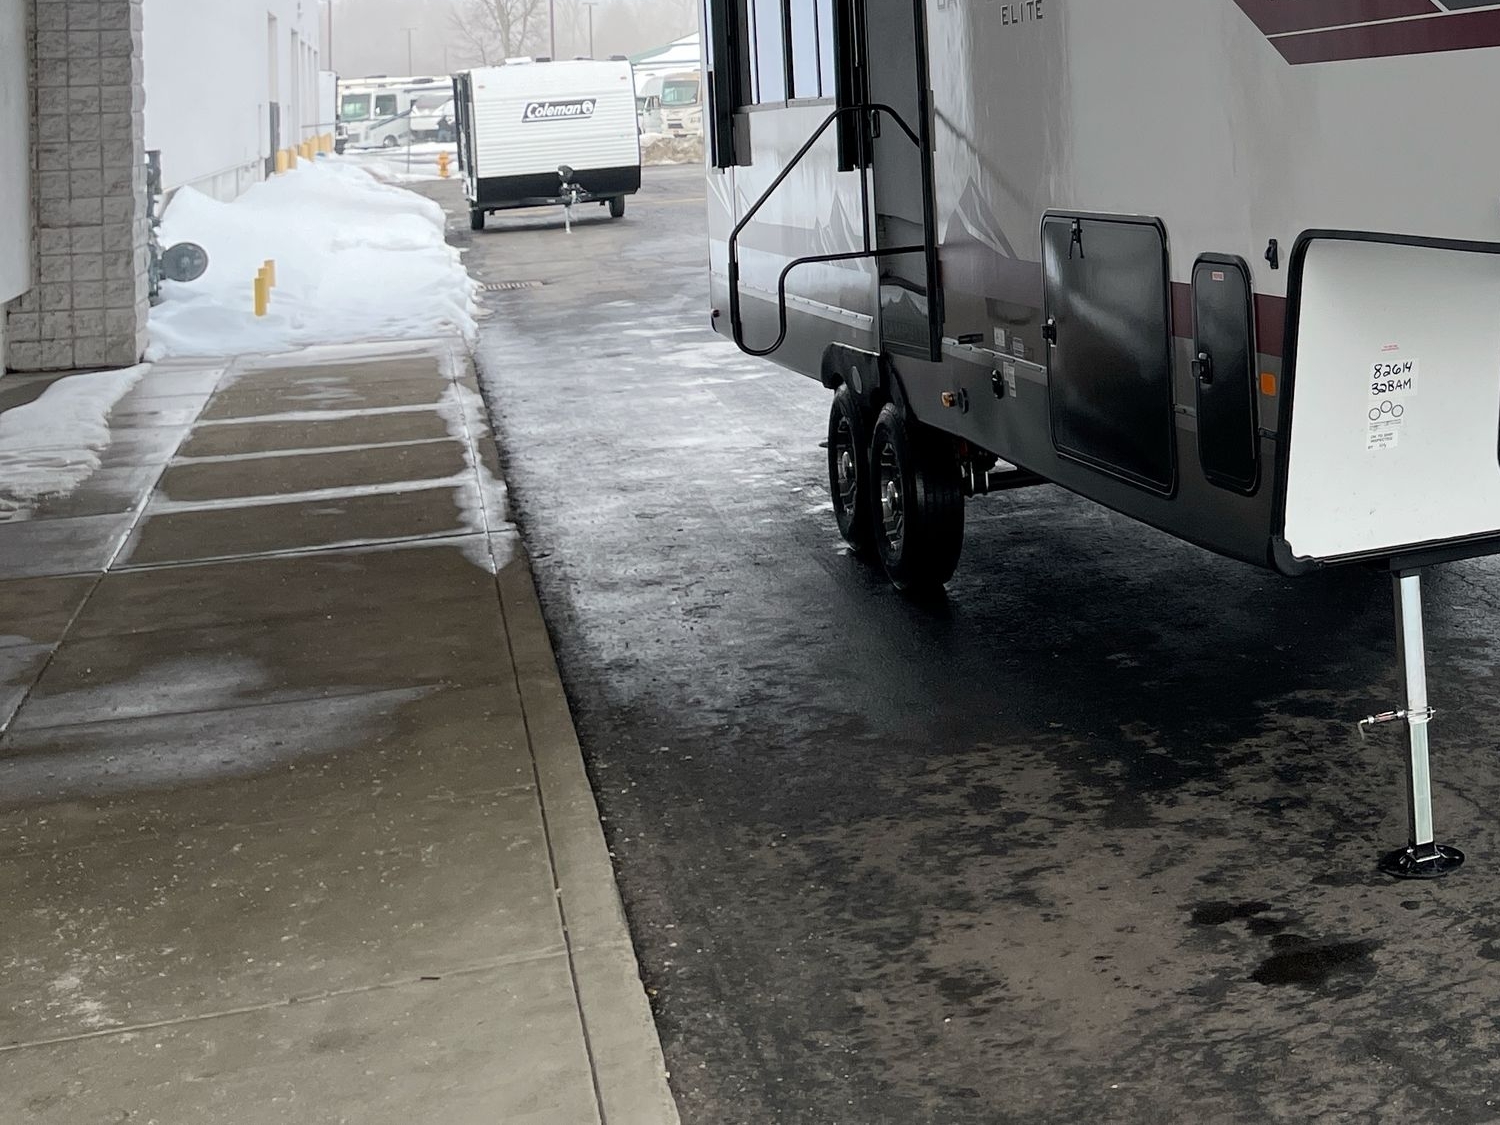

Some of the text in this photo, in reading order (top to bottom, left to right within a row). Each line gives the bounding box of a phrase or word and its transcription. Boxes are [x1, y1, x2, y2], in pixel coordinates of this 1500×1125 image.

[1001, 0, 1043, 26] ELITE
[527, 103, 580, 118] Coleman
[1373, 361, 1412, 379] 82614
[1371, 377, 1411, 395] 32BAM
